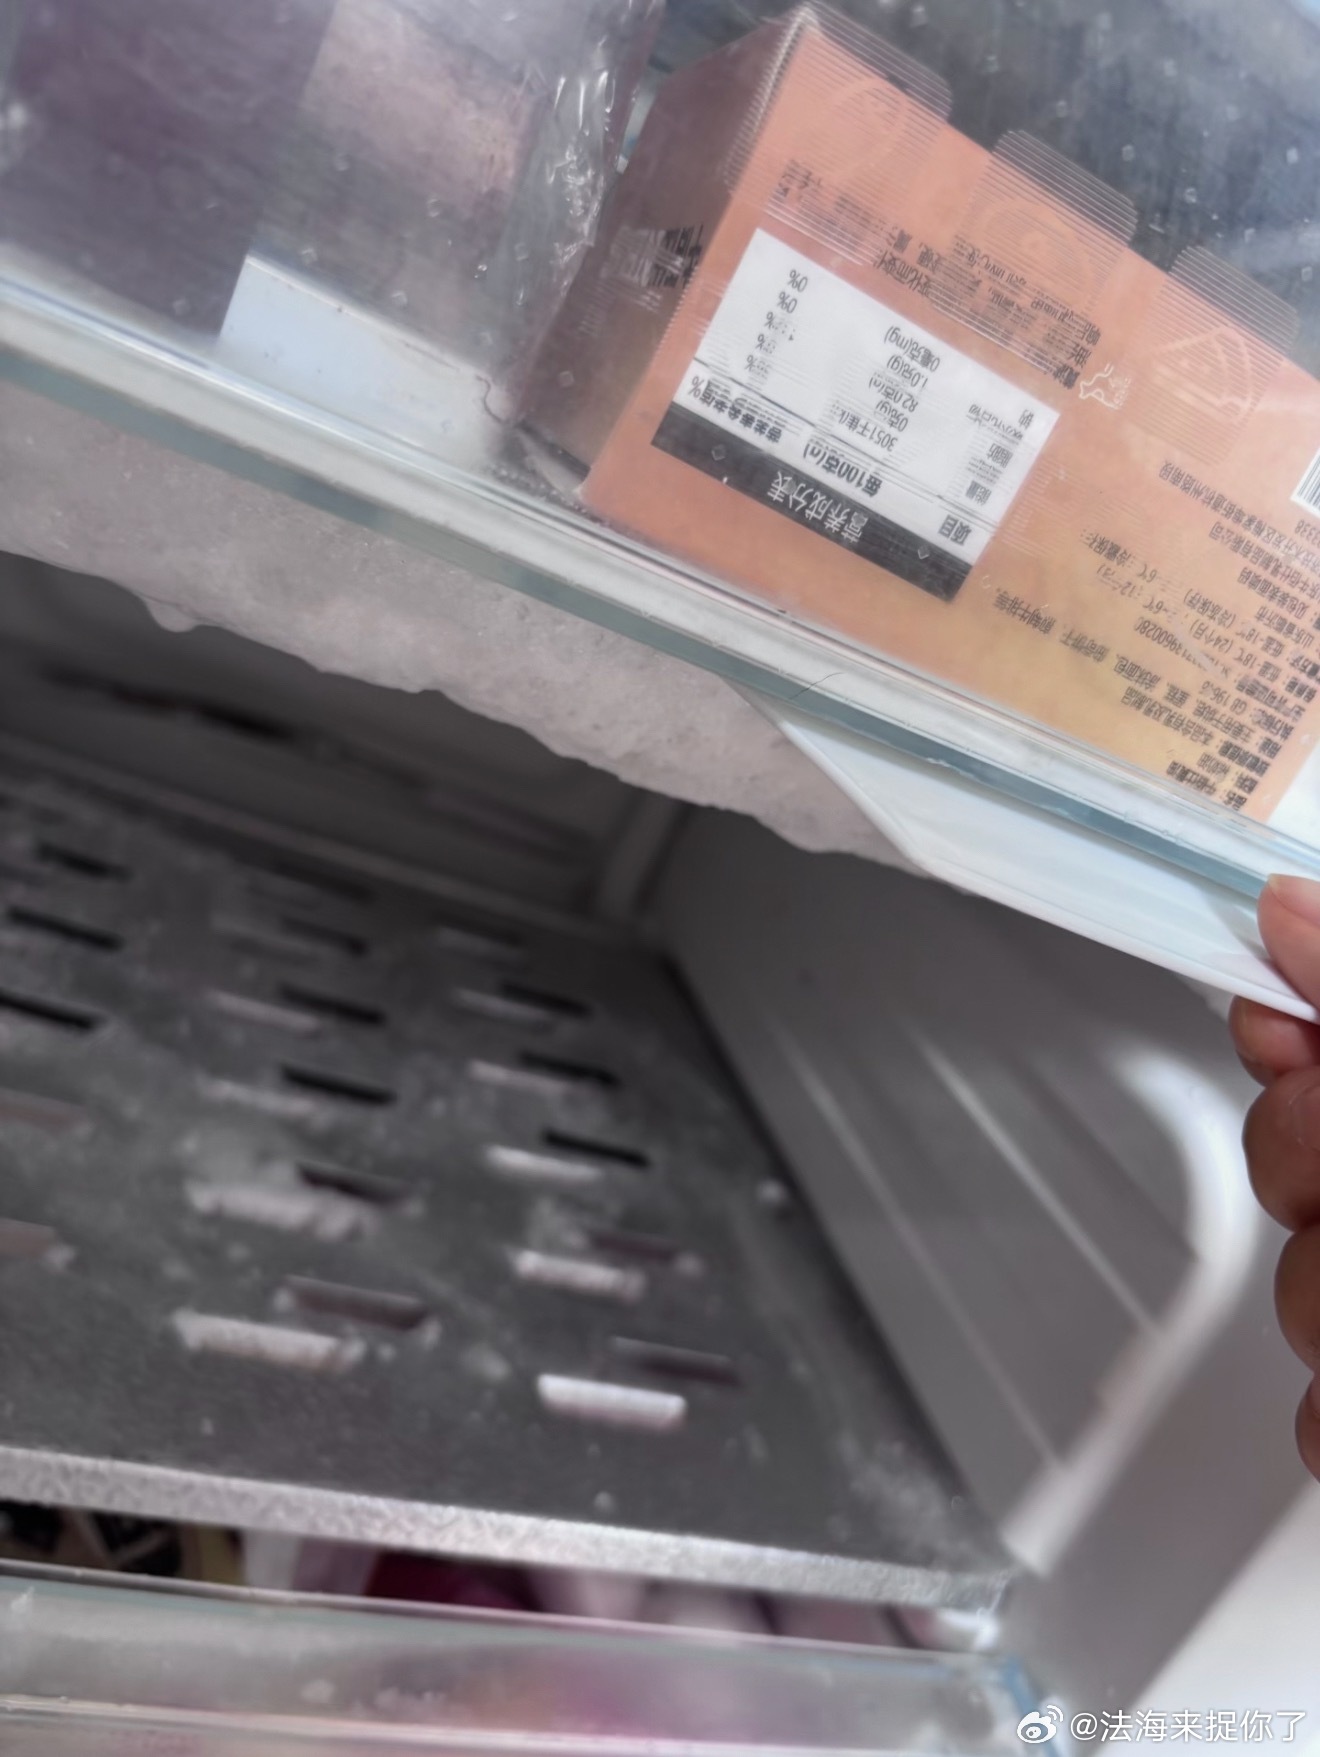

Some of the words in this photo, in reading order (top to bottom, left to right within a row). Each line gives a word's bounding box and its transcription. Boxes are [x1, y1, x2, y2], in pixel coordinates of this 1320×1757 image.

[784, 268, 810, 293] 0%
[773, 290, 799, 314] 0%
[881, 323, 941, 371] 0毫克(mg)
[884, 352, 929, 391] 1.0克(g)
[871, 398, 910, 432] 0克(g)
[1016, 408, 1035, 429] 钠
[984, 441, 1013, 468] 脂肪
[765, 470, 868, 543] 营养成分表
[963, 479, 992, 506] 能量
[937, 513, 972, 546] 项目
[1207, 520, 1318, 601] 东牛佰仕乳制品有限公司
